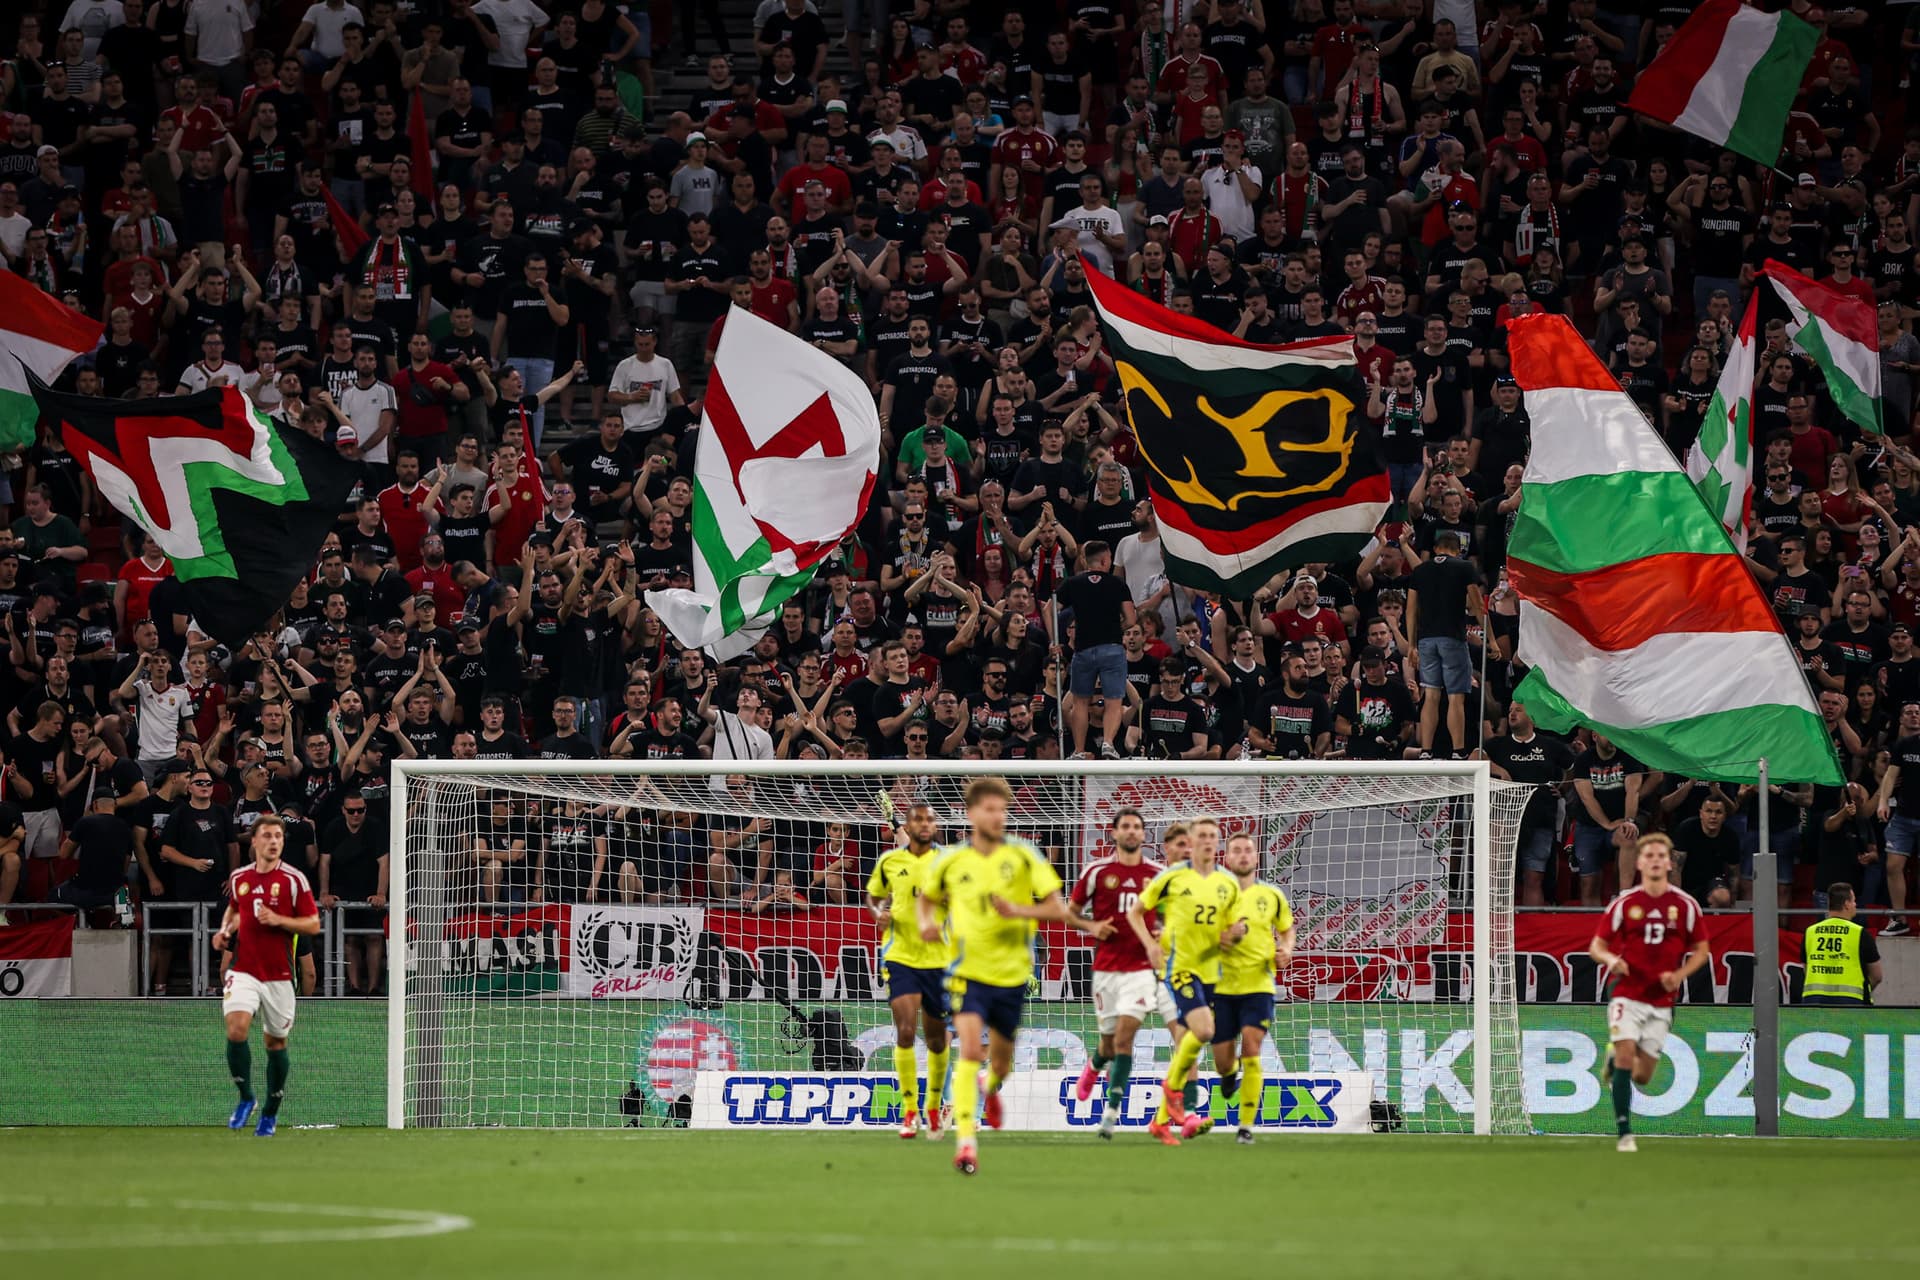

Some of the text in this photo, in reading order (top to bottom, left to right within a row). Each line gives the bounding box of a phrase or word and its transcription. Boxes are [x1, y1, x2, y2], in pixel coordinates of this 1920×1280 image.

[328, 370, 358, 382] TEAM
[1510, 752, 1545, 762] adidas
[1118, 891, 1139, 913] 10
[1194, 904, 1217, 925] 22
[1643, 923, 1666, 945] 13
[1816, 937, 1843, 952] 246
[1522, 1028, 1920, 1120] BOZSI
